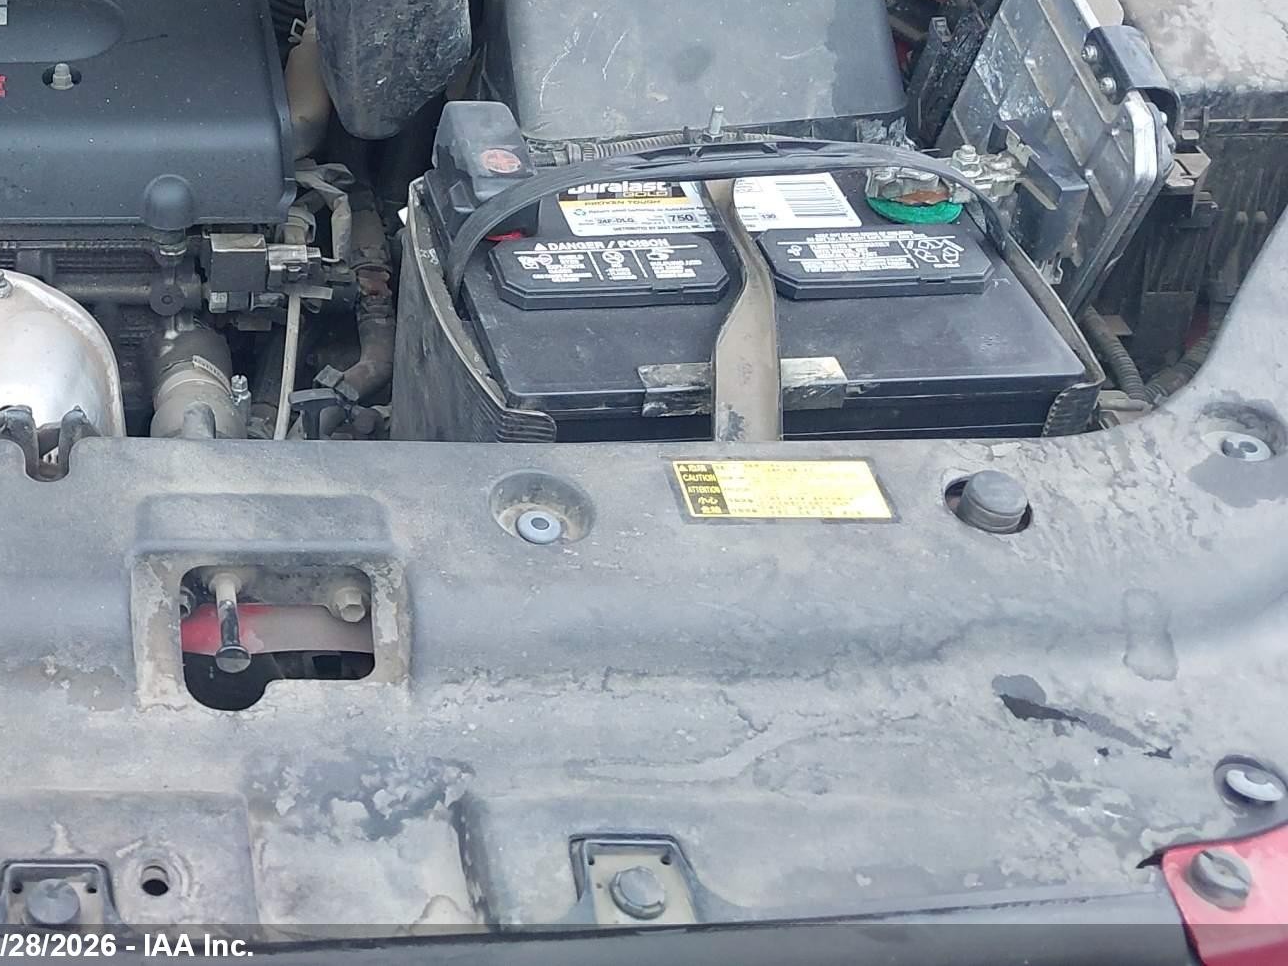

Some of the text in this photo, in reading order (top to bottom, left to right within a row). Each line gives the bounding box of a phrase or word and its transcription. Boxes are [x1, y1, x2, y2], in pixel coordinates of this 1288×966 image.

[670, 214, 694, 222] 750
[547, 241, 605, 250] DANGER
[618, 238, 670, 248] POISON
[682, 473, 716, 482] CAUTION
[687, 486, 721, 494] ATTENTION
